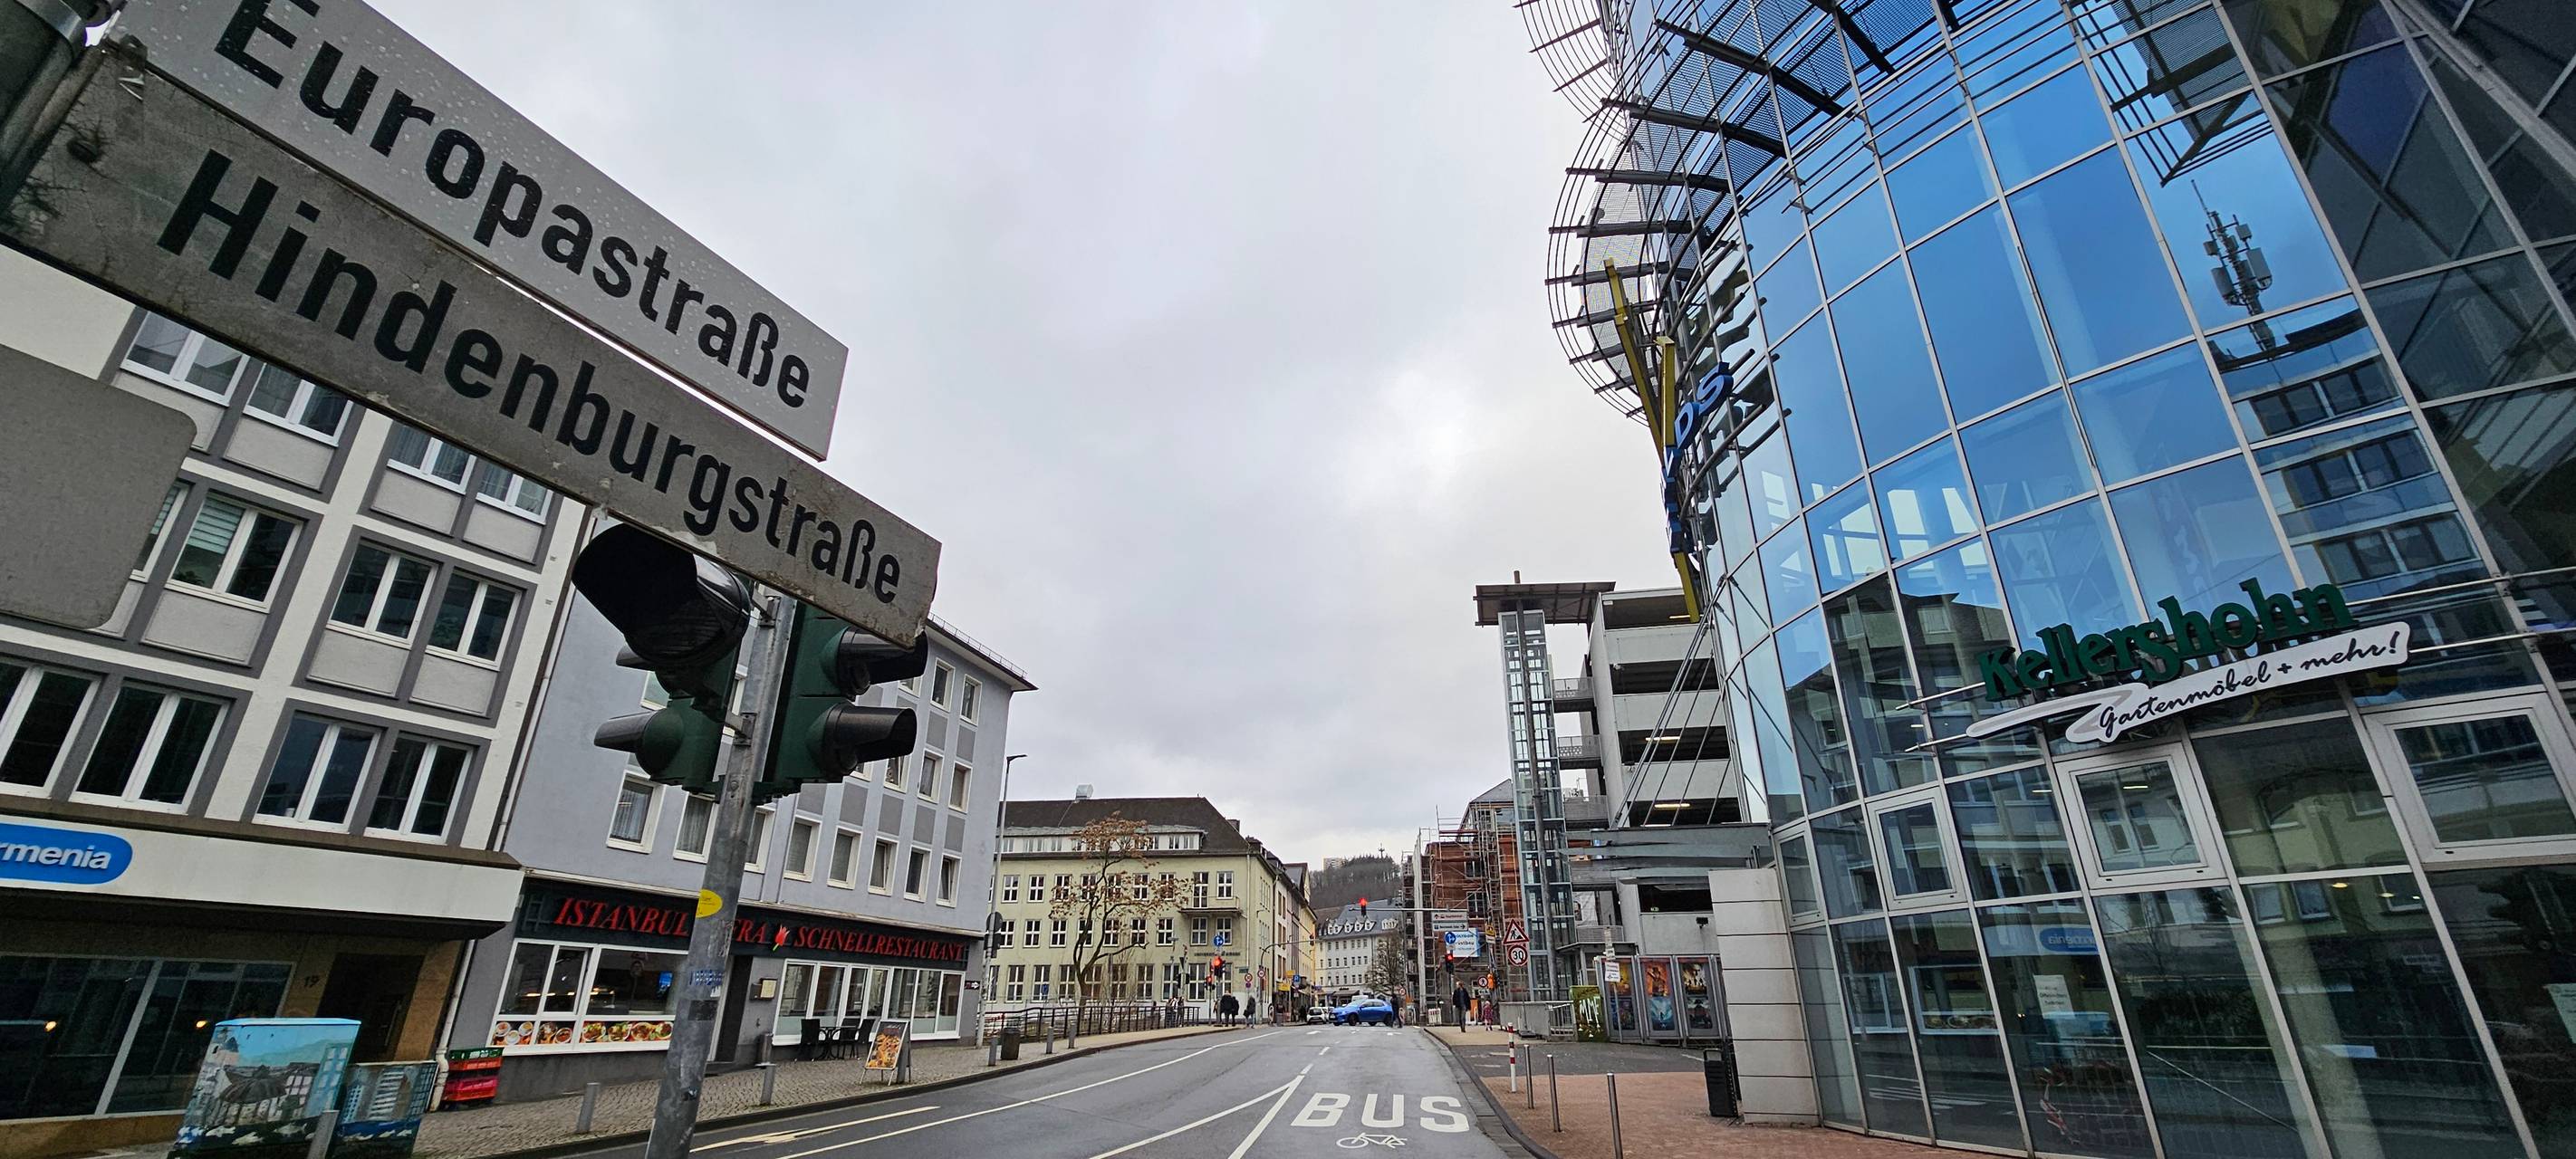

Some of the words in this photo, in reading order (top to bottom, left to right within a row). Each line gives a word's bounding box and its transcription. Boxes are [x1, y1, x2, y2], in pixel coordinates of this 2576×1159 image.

[214, 0, 810, 407] Europastraße
[157, 148, 900, 605] Hindenburgstraße
[1977, 578, 2356, 702] Kellershohn
[2099, 660, 2273, 736] Gartenmöbel
[2301, 631, 2400, 671] mehr!
[553, 897, 689, 937] ISTANBUL
[793, 925, 965, 962] SCHNELLRESTAURANT
[1512, 950, 1523, 960] 30
[1291, 1093, 1471, 1133] BUS
